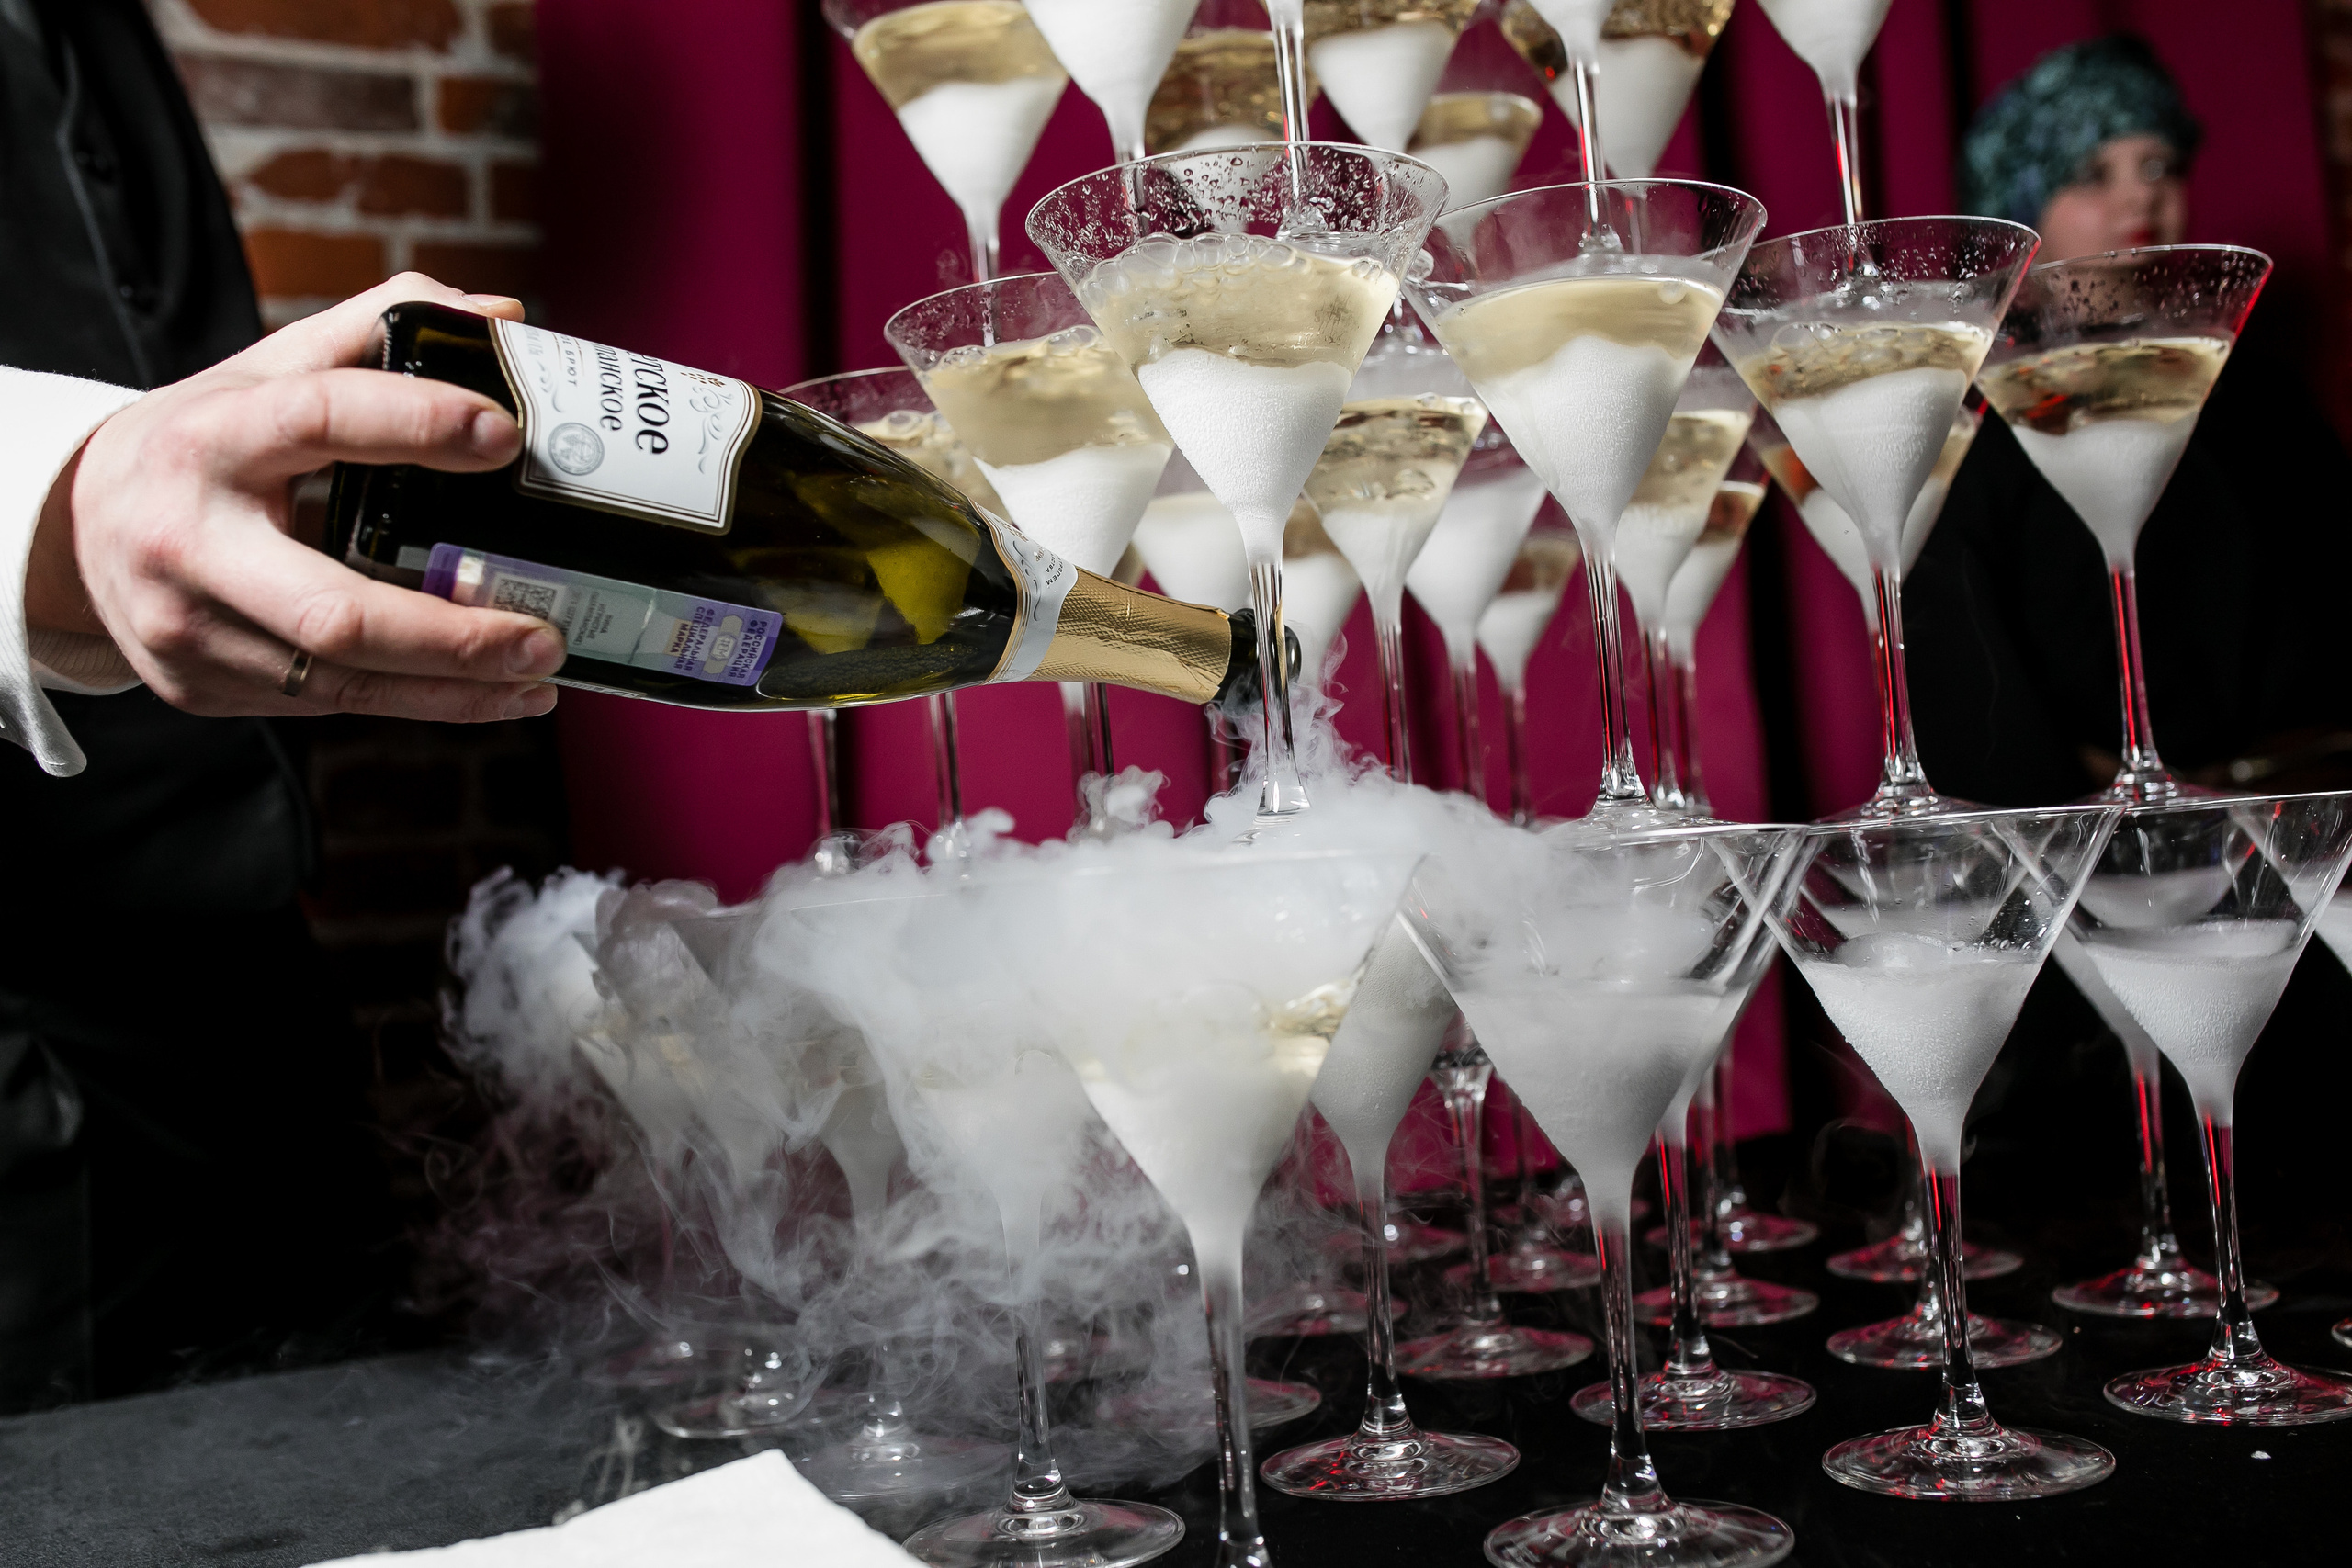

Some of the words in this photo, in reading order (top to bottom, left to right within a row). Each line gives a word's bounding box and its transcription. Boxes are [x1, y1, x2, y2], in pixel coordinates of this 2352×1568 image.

[565, 349, 578, 387] БРЮТ
[670, 623, 689, 653] МАРКА
[673, 606, 706, 670] СПЕЦИАЛЬНАЯ
[684, 608, 715, 671] ФЕДЕРАЛЬНАЯ
[728, 619, 758, 678] ФЕДЕРАЦИЯ
[737, 620, 768, 679] РОССИЙСКАЯ
